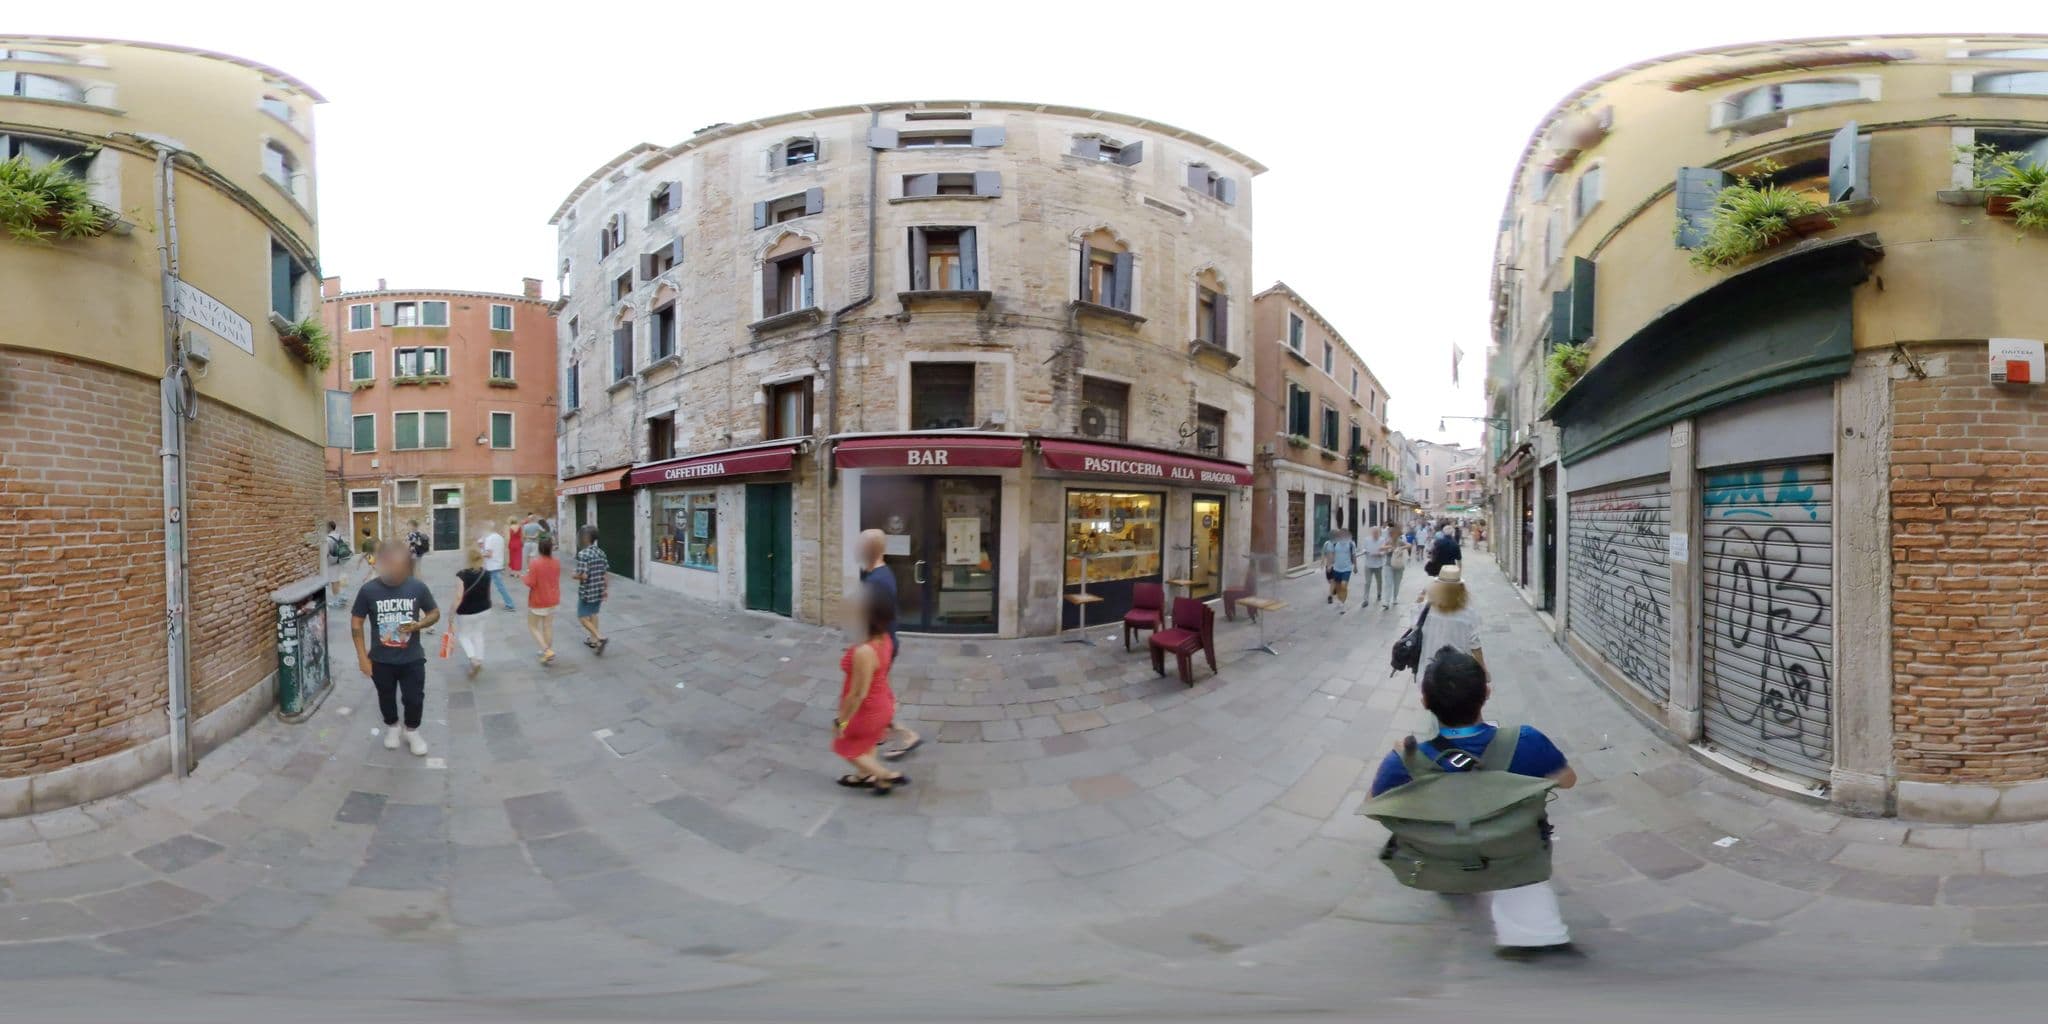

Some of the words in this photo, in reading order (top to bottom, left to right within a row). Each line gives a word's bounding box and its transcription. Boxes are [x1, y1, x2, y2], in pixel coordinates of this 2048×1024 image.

[907, 450, 948, 465] BAR
[665, 463, 725, 479] CAFFETTERIA
[1084, 457, 1163, 476] PASTICCERIA
[1171, 467, 1195, 479] ALLA
[1201, 471, 1236, 484] BRAGORA
